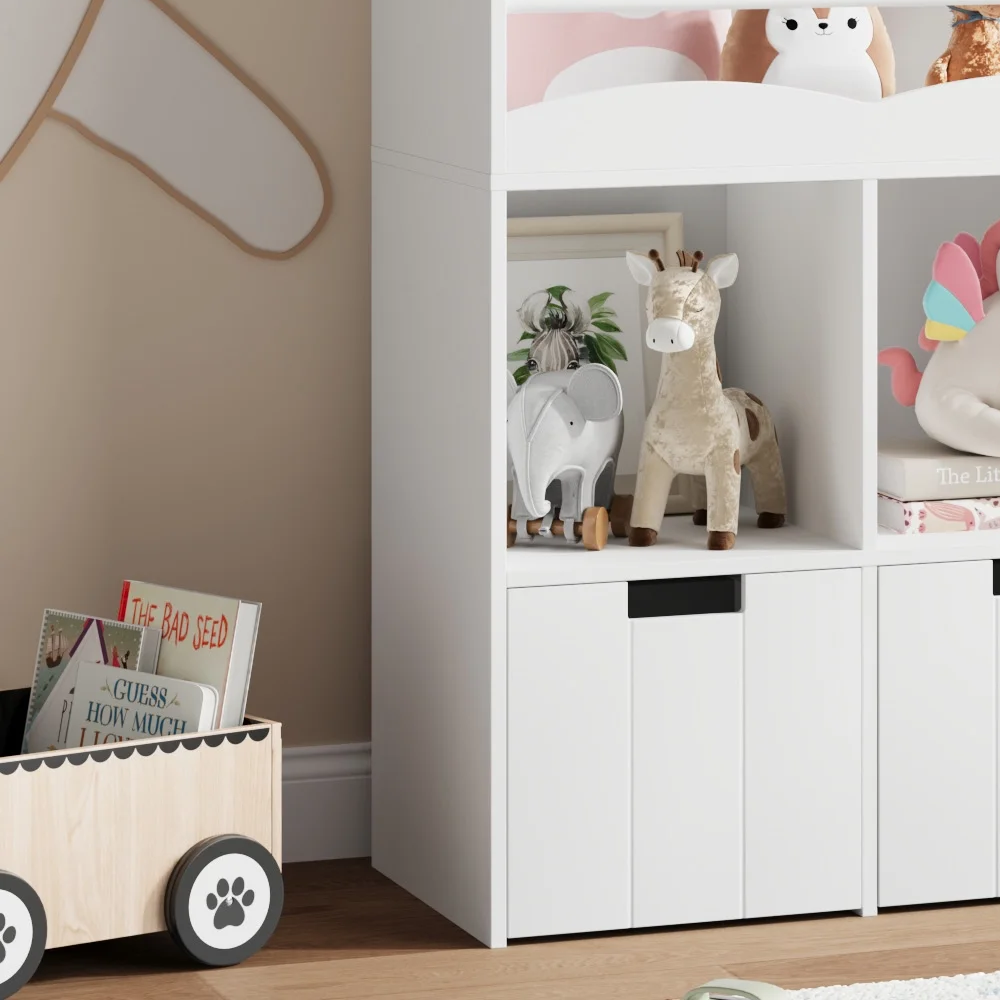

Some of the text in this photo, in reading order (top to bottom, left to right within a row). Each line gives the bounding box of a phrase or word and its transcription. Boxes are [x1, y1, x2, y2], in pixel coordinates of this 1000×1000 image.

[936, 467, 970, 485] The
[132, 598, 229, 651] THE BAD SEED
[113, 678, 168, 709] GUESS
[86, 701, 187, 736] HOW MUCH
